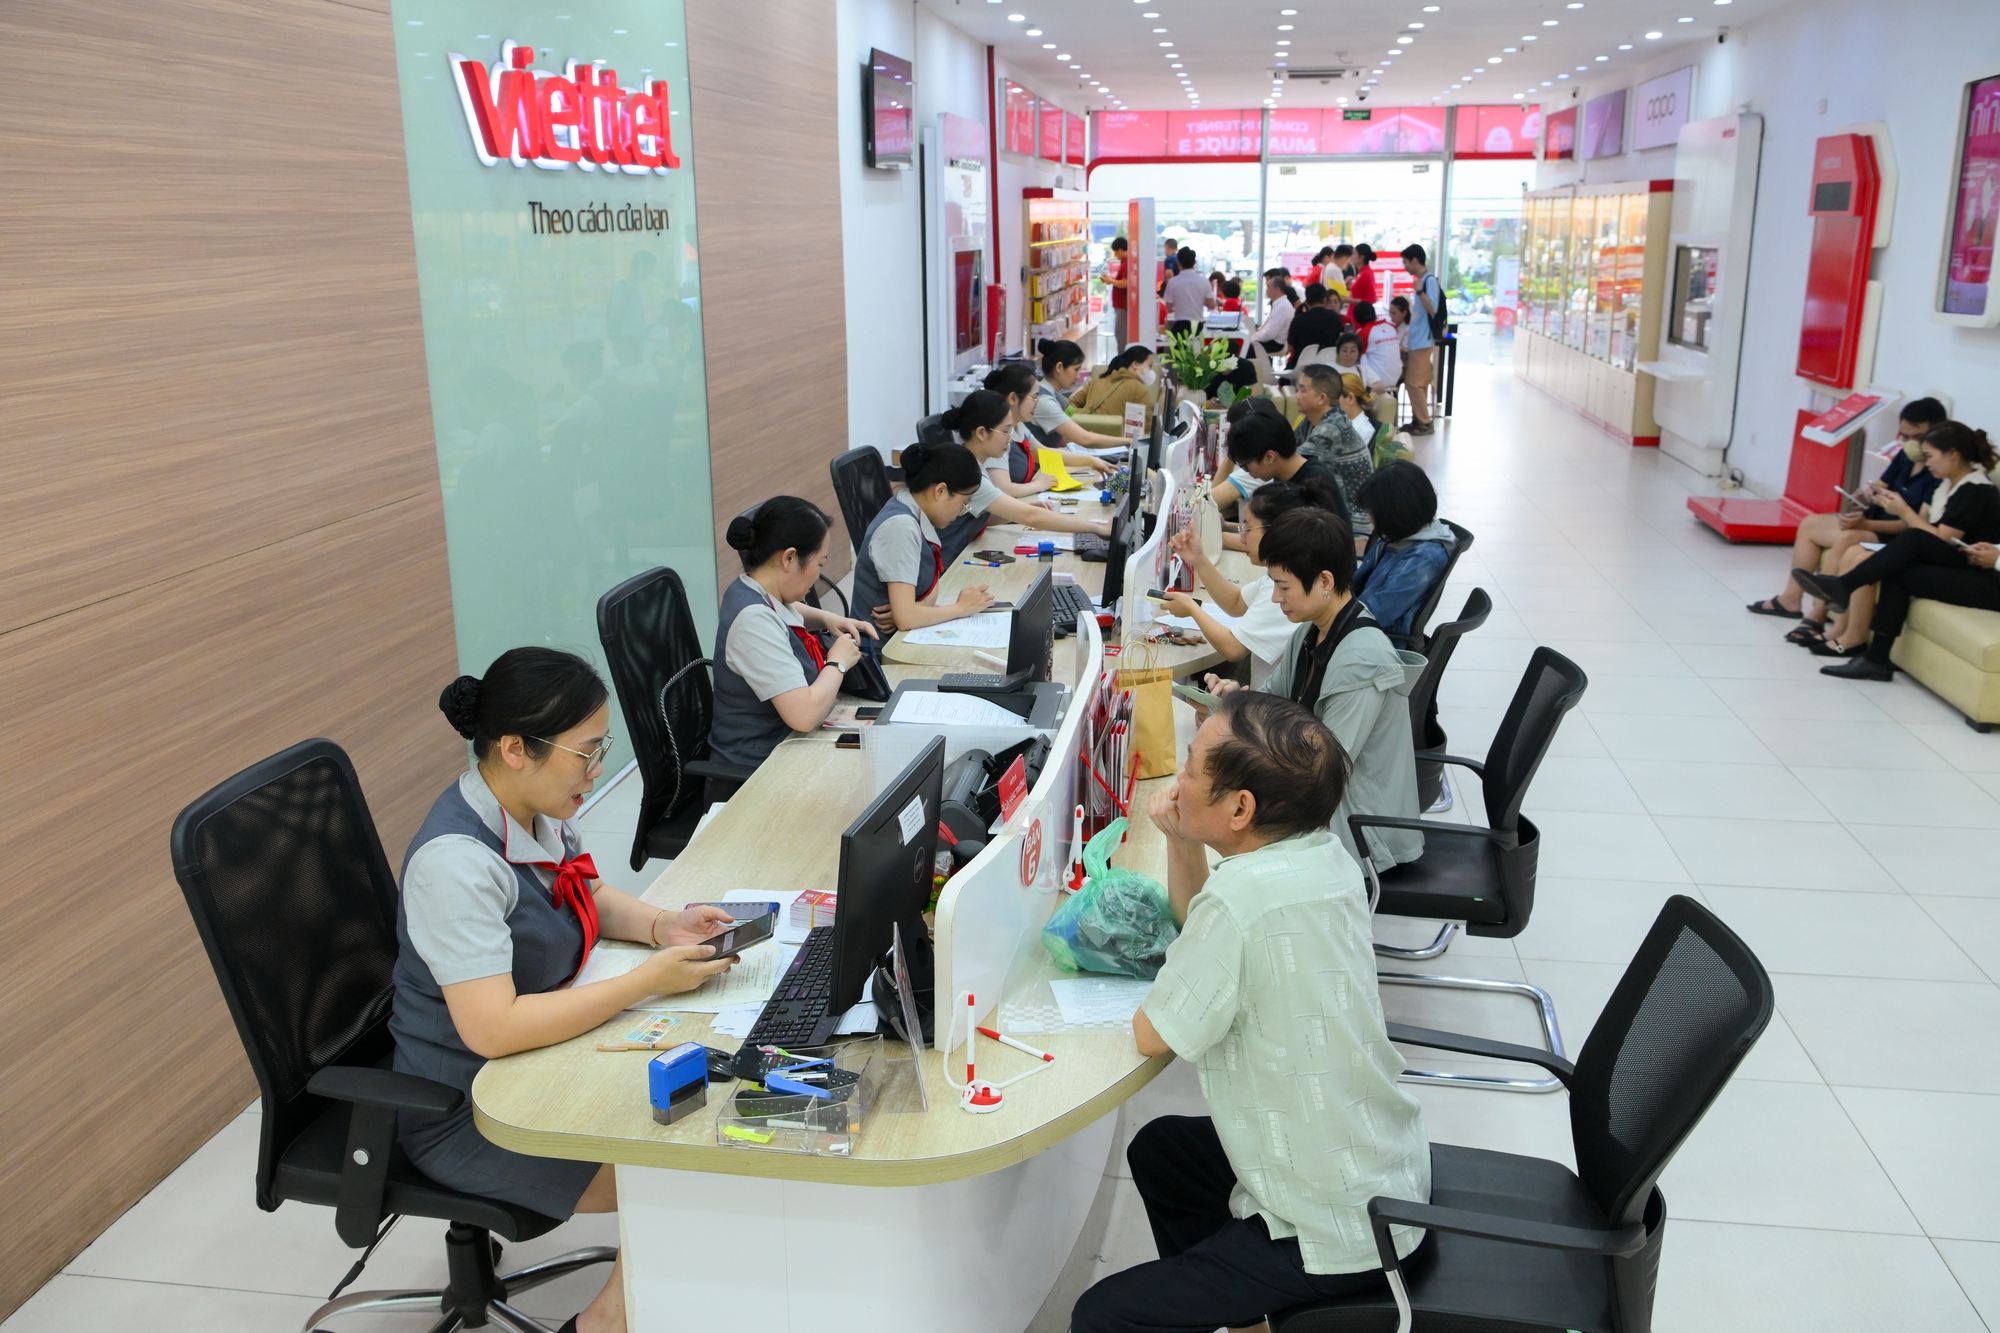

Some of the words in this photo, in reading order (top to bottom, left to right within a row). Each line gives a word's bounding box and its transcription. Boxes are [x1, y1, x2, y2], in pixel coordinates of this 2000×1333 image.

[1646, 92, 1677, 126] oppo
[528, 201, 574, 235] Theo
[577, 201, 615, 233] cách
[617, 202, 643, 232] của
[644, 202, 670, 237] bạn
[1026, 825, 1041, 855] BÀN
[1028, 848, 1037, 881] 6
